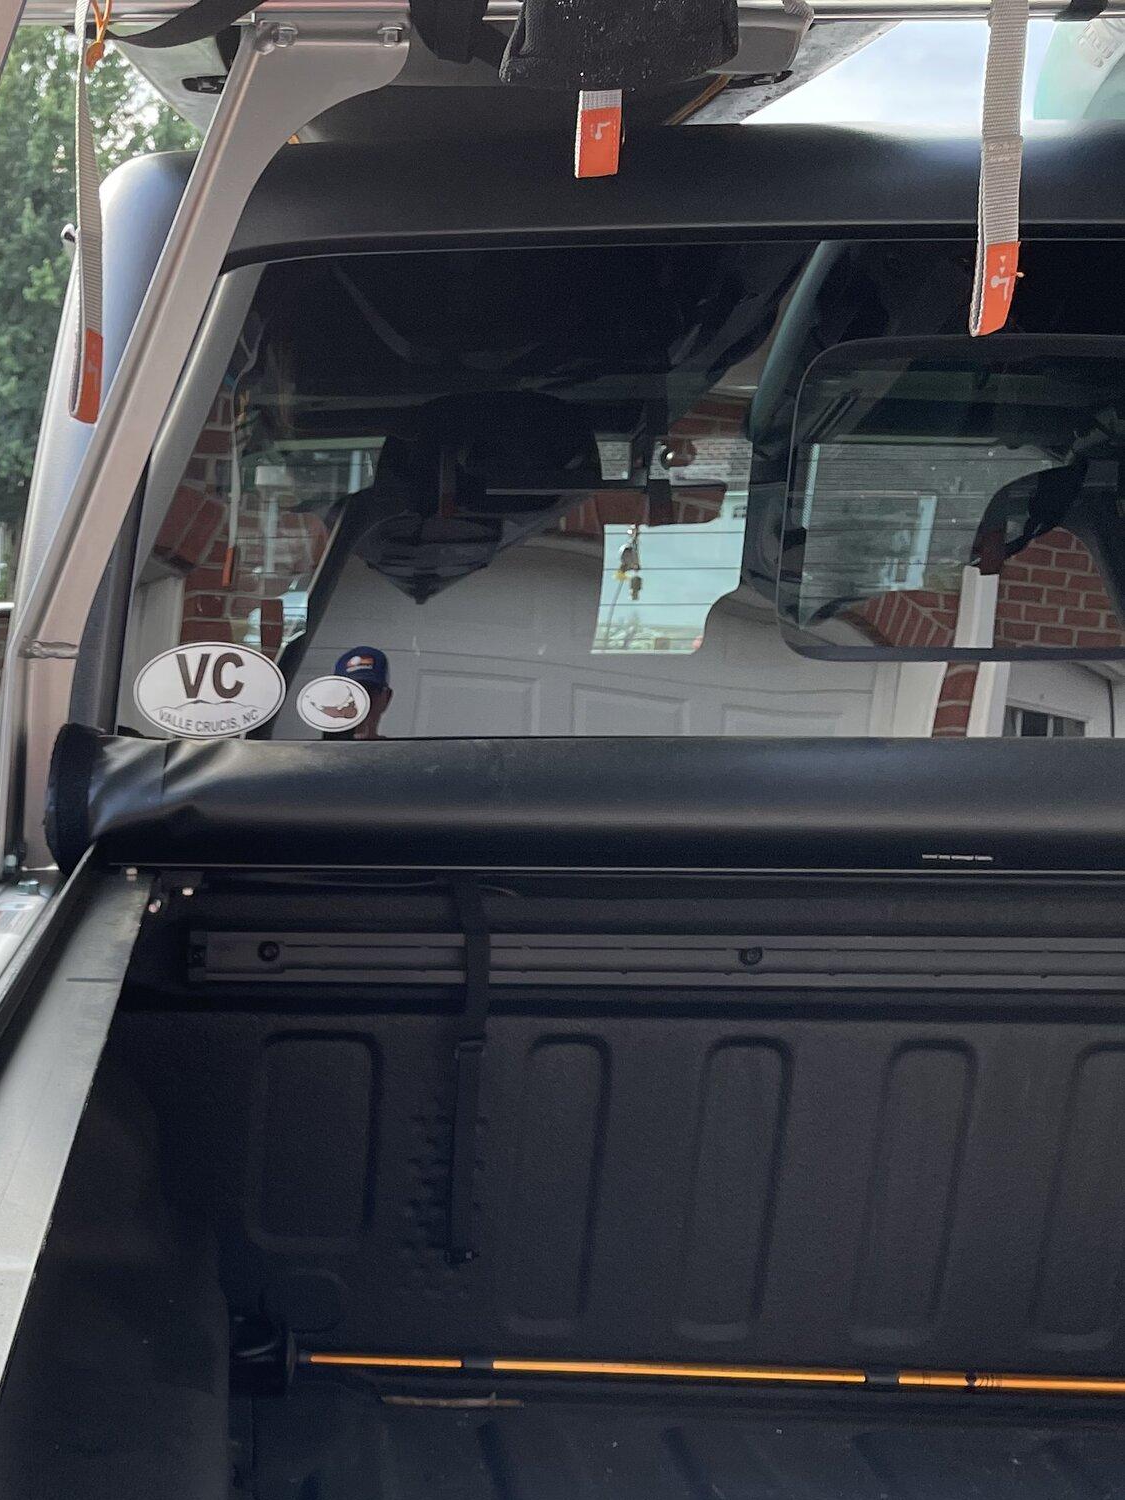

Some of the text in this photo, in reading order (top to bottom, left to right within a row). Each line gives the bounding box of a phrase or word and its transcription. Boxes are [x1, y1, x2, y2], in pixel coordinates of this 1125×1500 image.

[176, 652, 245, 699] VC
[158, 709, 259, 733] VALLE CRUCIS, NC
